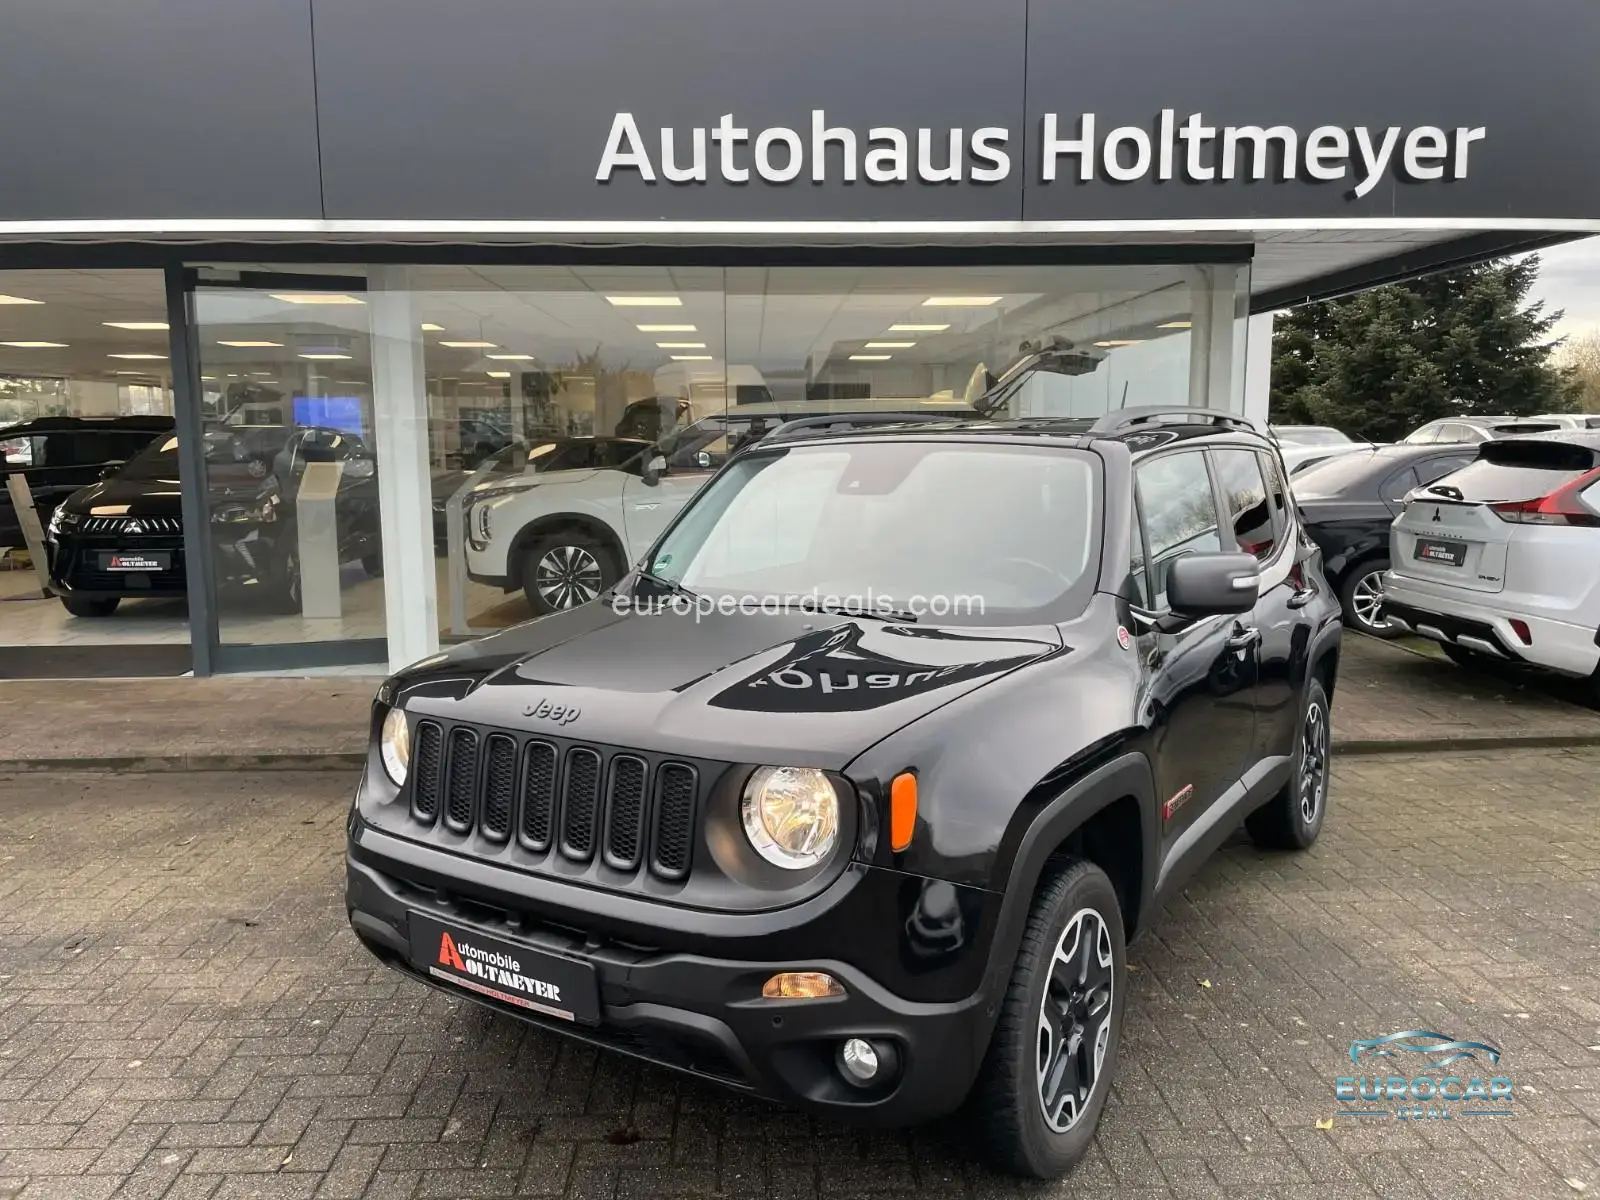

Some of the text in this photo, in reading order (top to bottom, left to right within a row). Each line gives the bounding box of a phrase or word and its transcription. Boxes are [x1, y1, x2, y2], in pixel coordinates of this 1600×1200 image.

[595, 108, 1487, 200] Autohaus Holtmeyer
[522, 698, 582, 726] Jeep
[439, 932, 520, 973] Automobile
